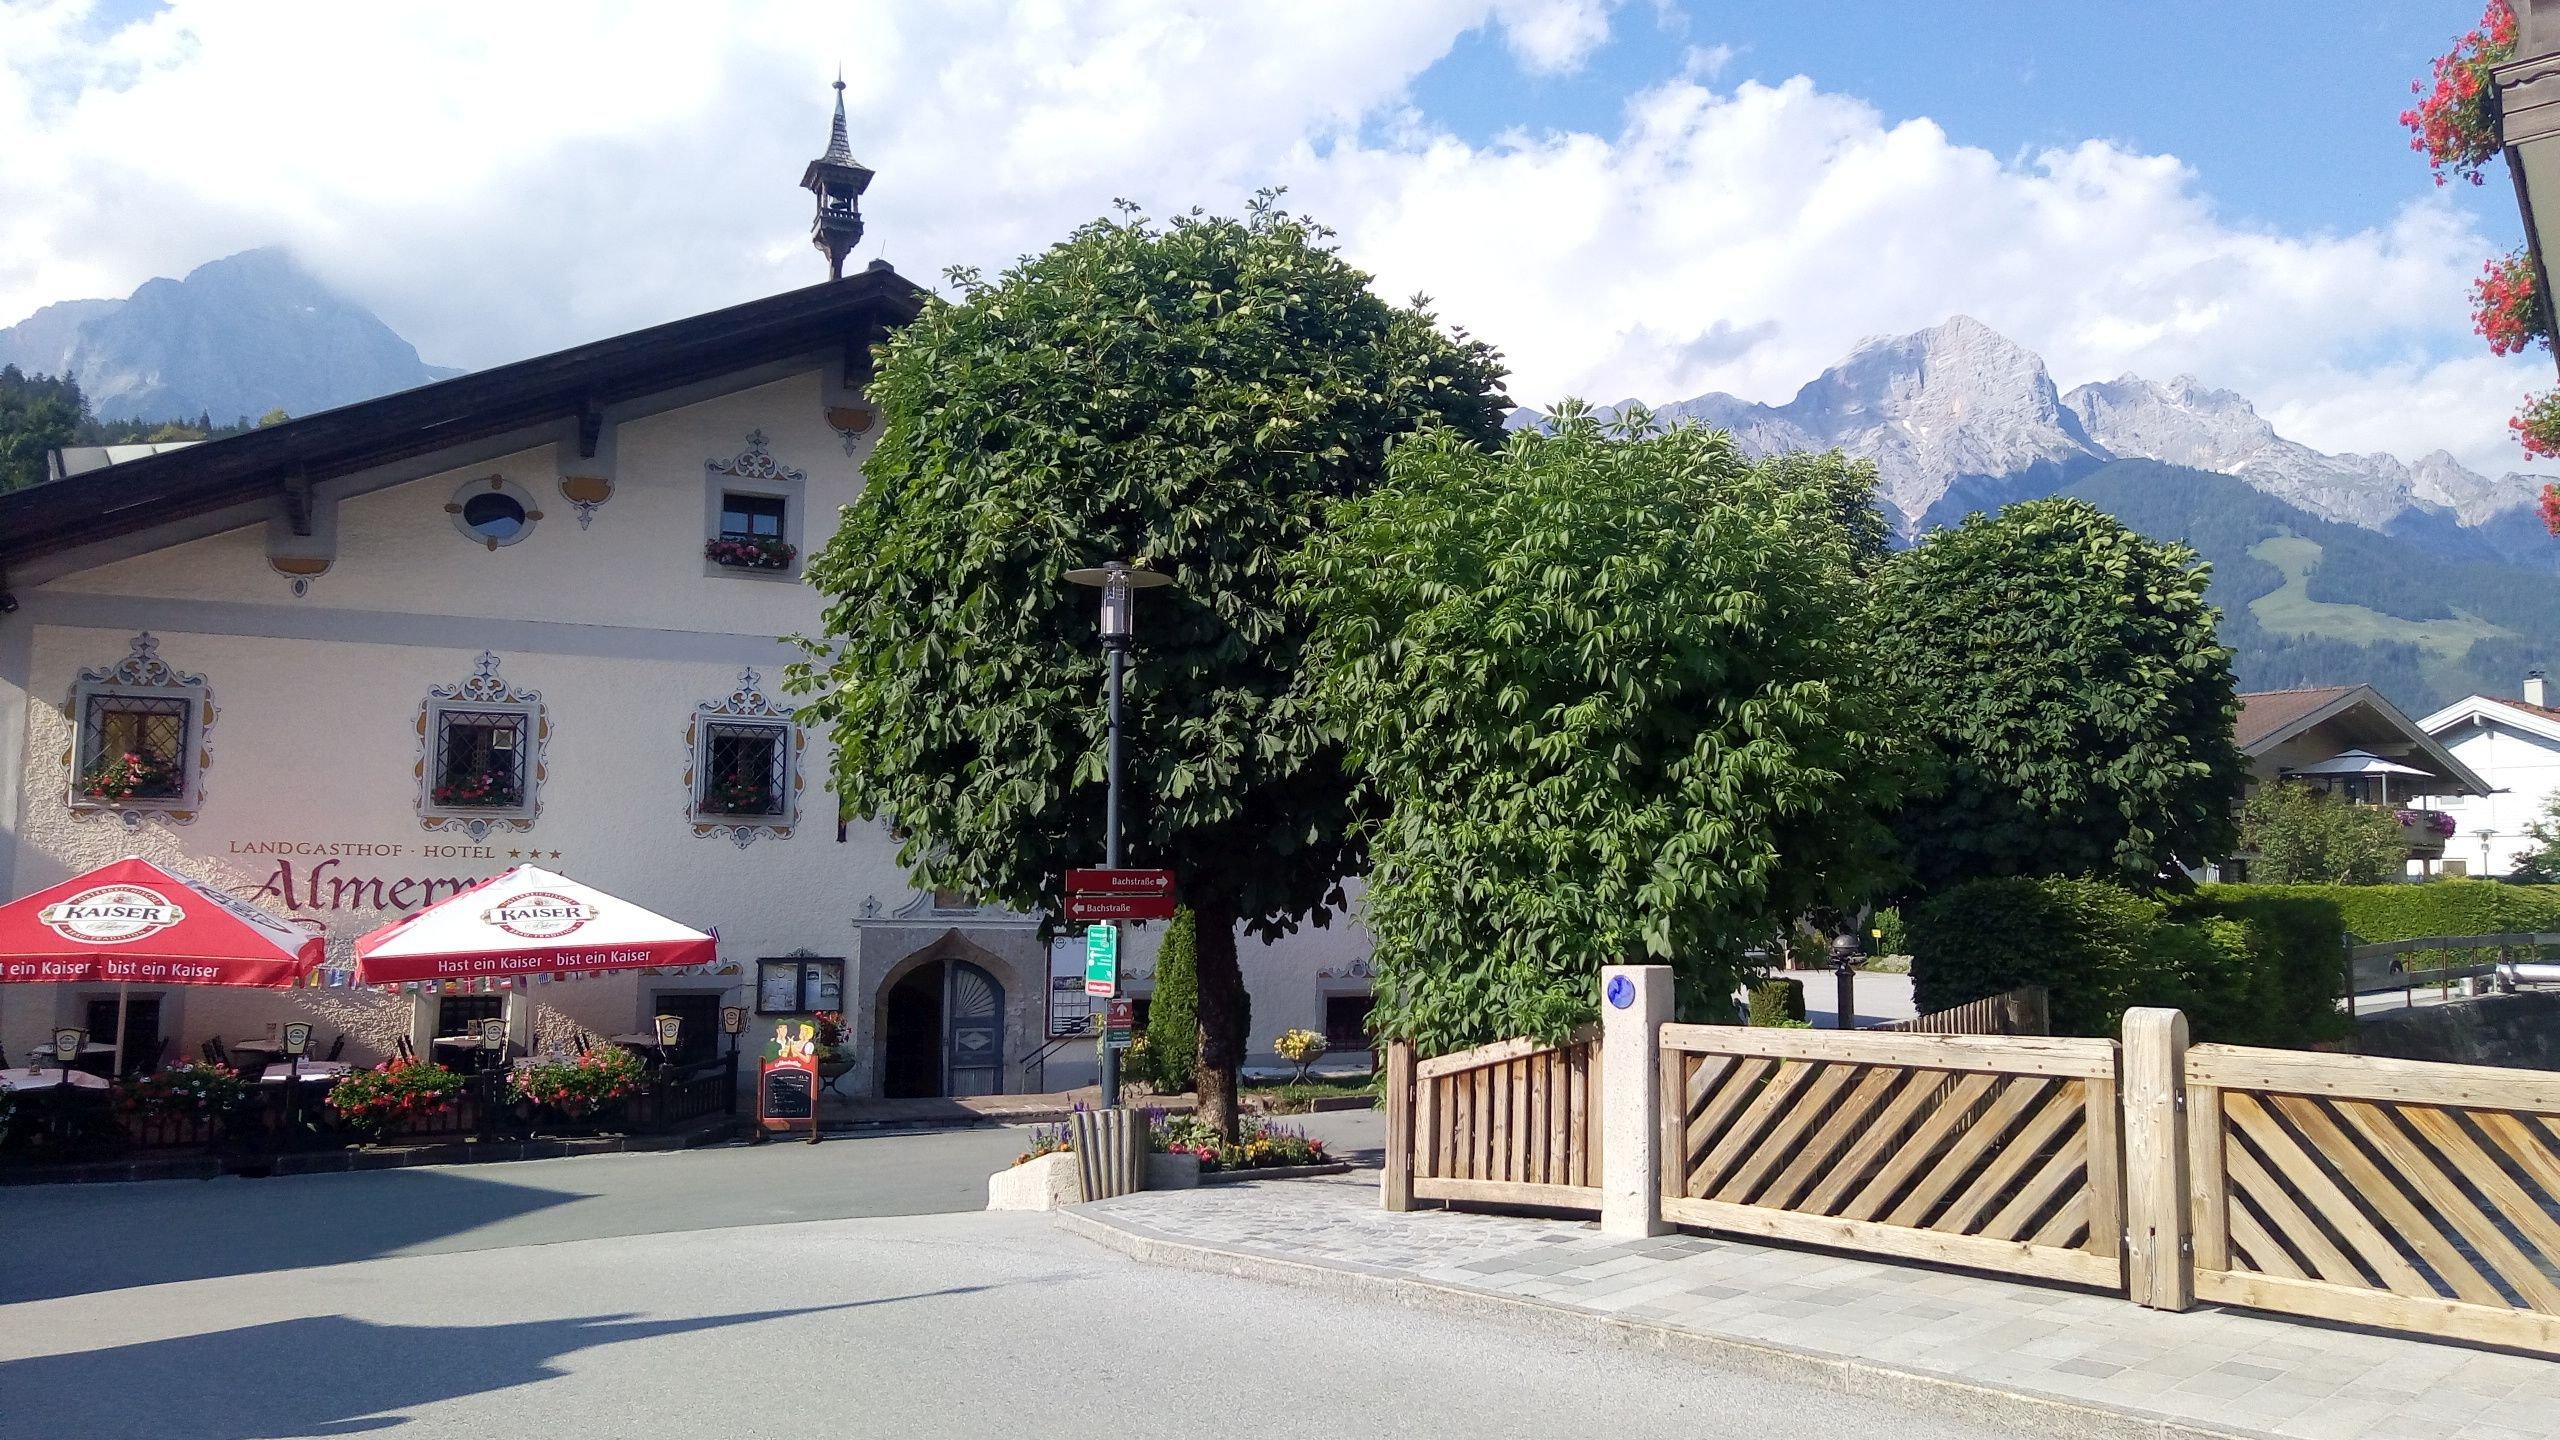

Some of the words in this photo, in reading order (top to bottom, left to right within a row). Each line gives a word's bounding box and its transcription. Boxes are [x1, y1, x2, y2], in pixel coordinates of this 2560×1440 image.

[229, 841, 403, 857] LANDGASTHOF
[424, 845, 495, 859] HOTEL
[1112, 877, 1154, 886] Bachstraße
[65, 906, 161, 920] KAISER
[501, 907, 581, 920] KAISER
[1087, 903, 1131, 912] Bachstraße
[438, 959, 469, 972] Hast
[473, 958, 496, 970] ein
[500, 955, 543, 969] Kaiser
[556, 952, 581, 966] bist
[585, 952, 606, 964] ein
[610, 949, 651, 963] Kaiser
[10, 962, 36, 975] ein
[41, 961, 91, 975] Kaiser
[107, 960, 136, 975] bist
[142, 962, 166, 976] ein
[171, 963, 219, 978] Kaiser
